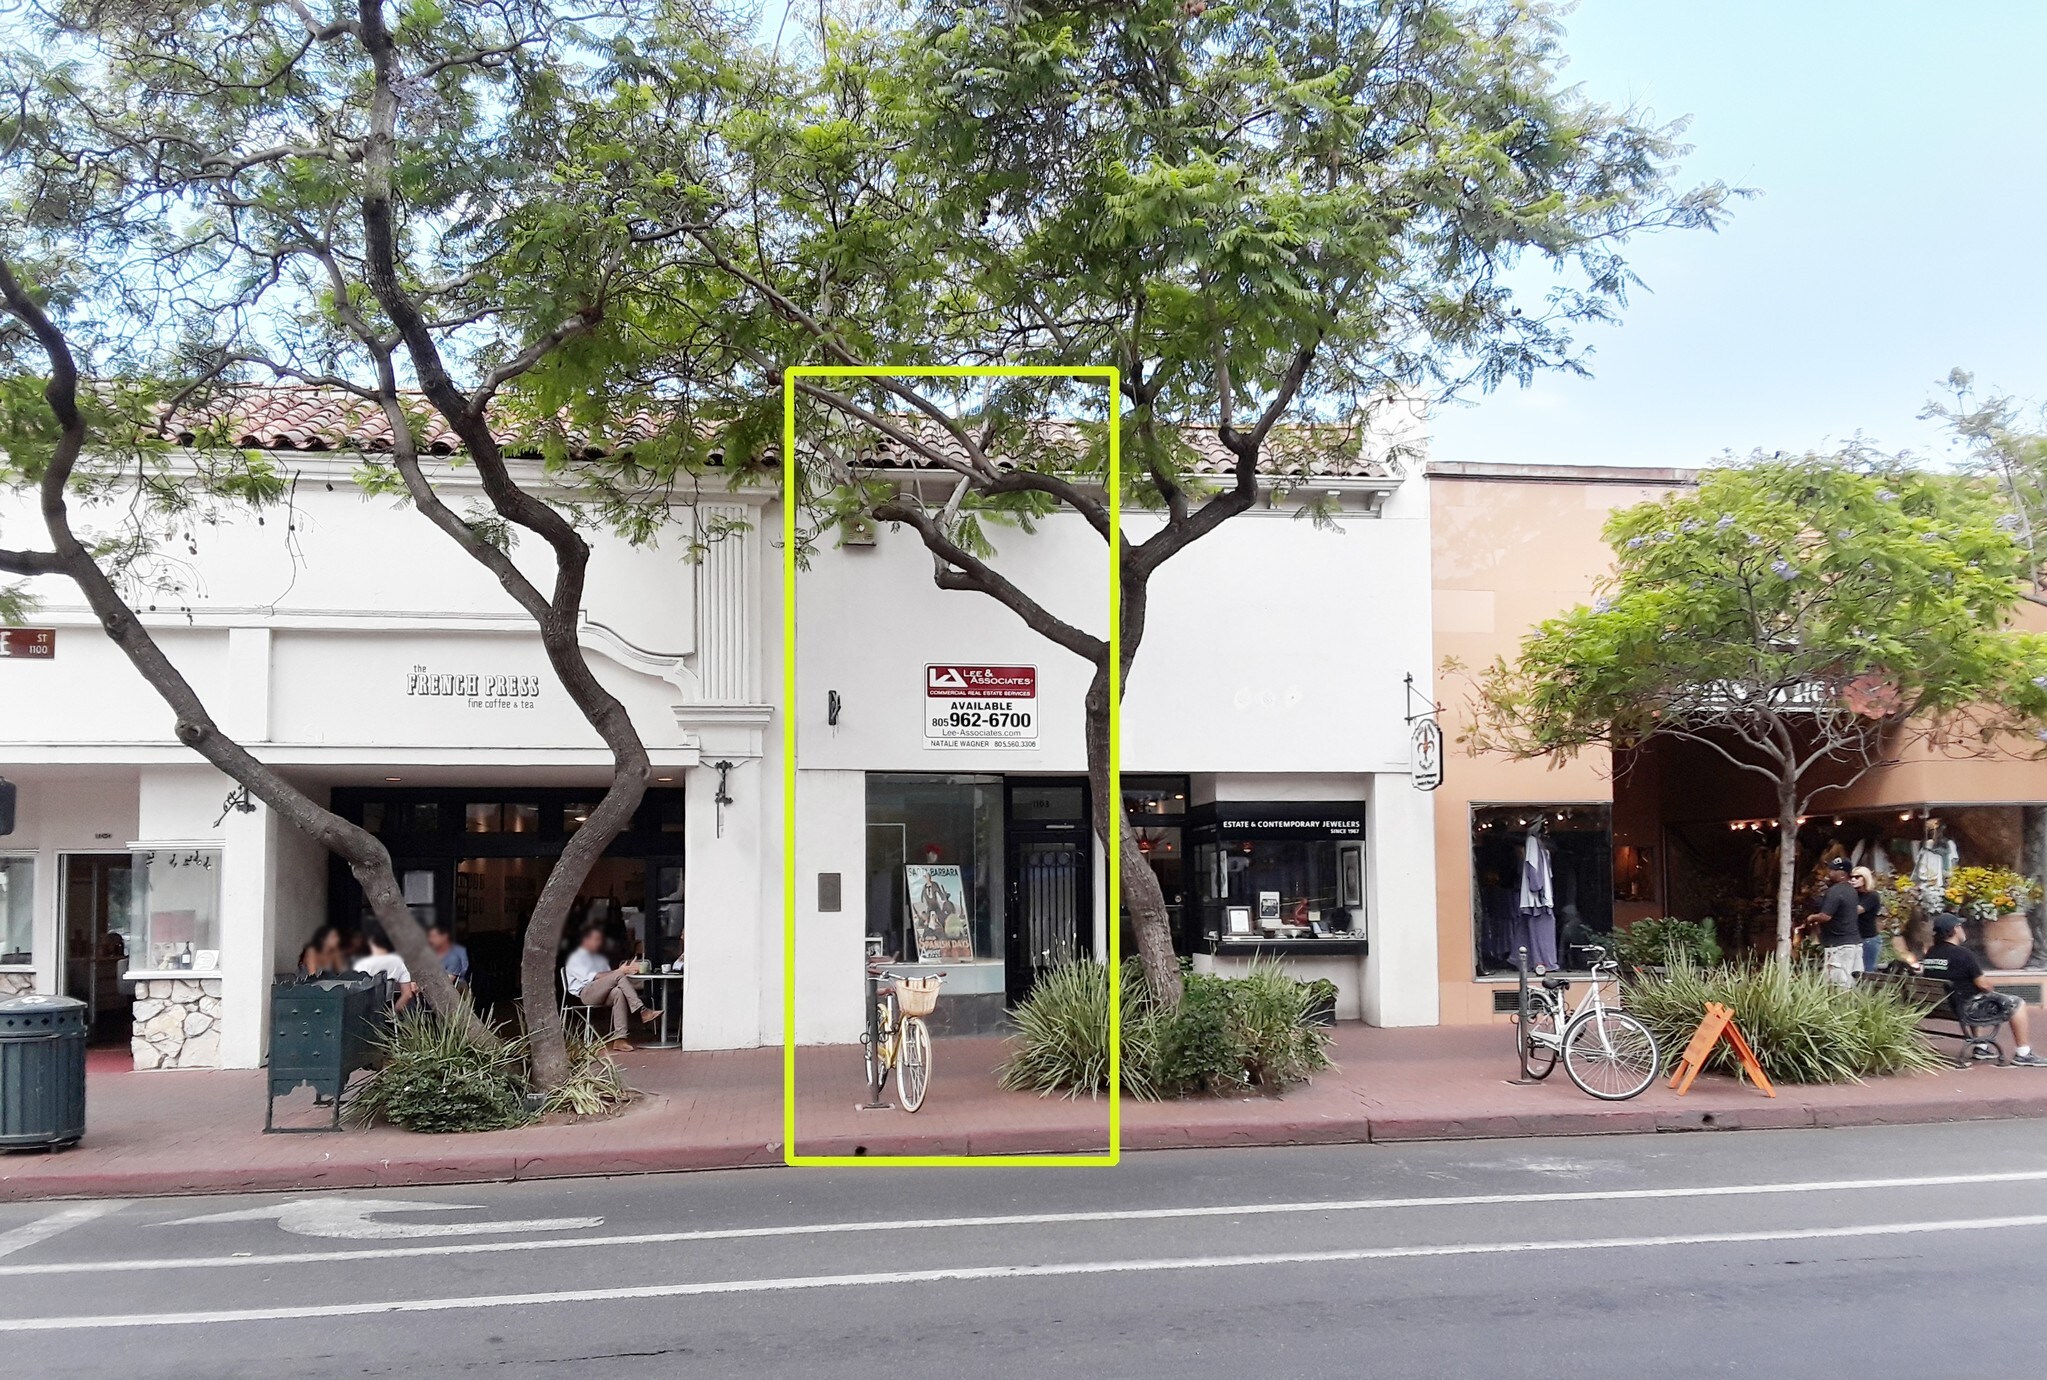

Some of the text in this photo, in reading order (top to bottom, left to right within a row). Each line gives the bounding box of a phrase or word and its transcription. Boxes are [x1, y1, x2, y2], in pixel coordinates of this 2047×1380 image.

[37, 633, 47, 642] ST
[29, 645, 48, 654] 1100
[413, 664, 427, 673] the
[984, 669, 994, 677] &
[407, 673, 540, 697] FRENCH PRESS
[970, 676, 1031, 685] ASSOCIATES
[468, 698, 483, 709] fine
[485, 699, 511, 709] coffee
[521, 700, 535, 709] tea
[950, 702, 1013, 711] AVAILABLE
[932, 712, 1031, 728] 805 962-6700
[942, 729, 1022, 737] Lee-Associates.com
[960, 740, 990, 748] WAGNER
